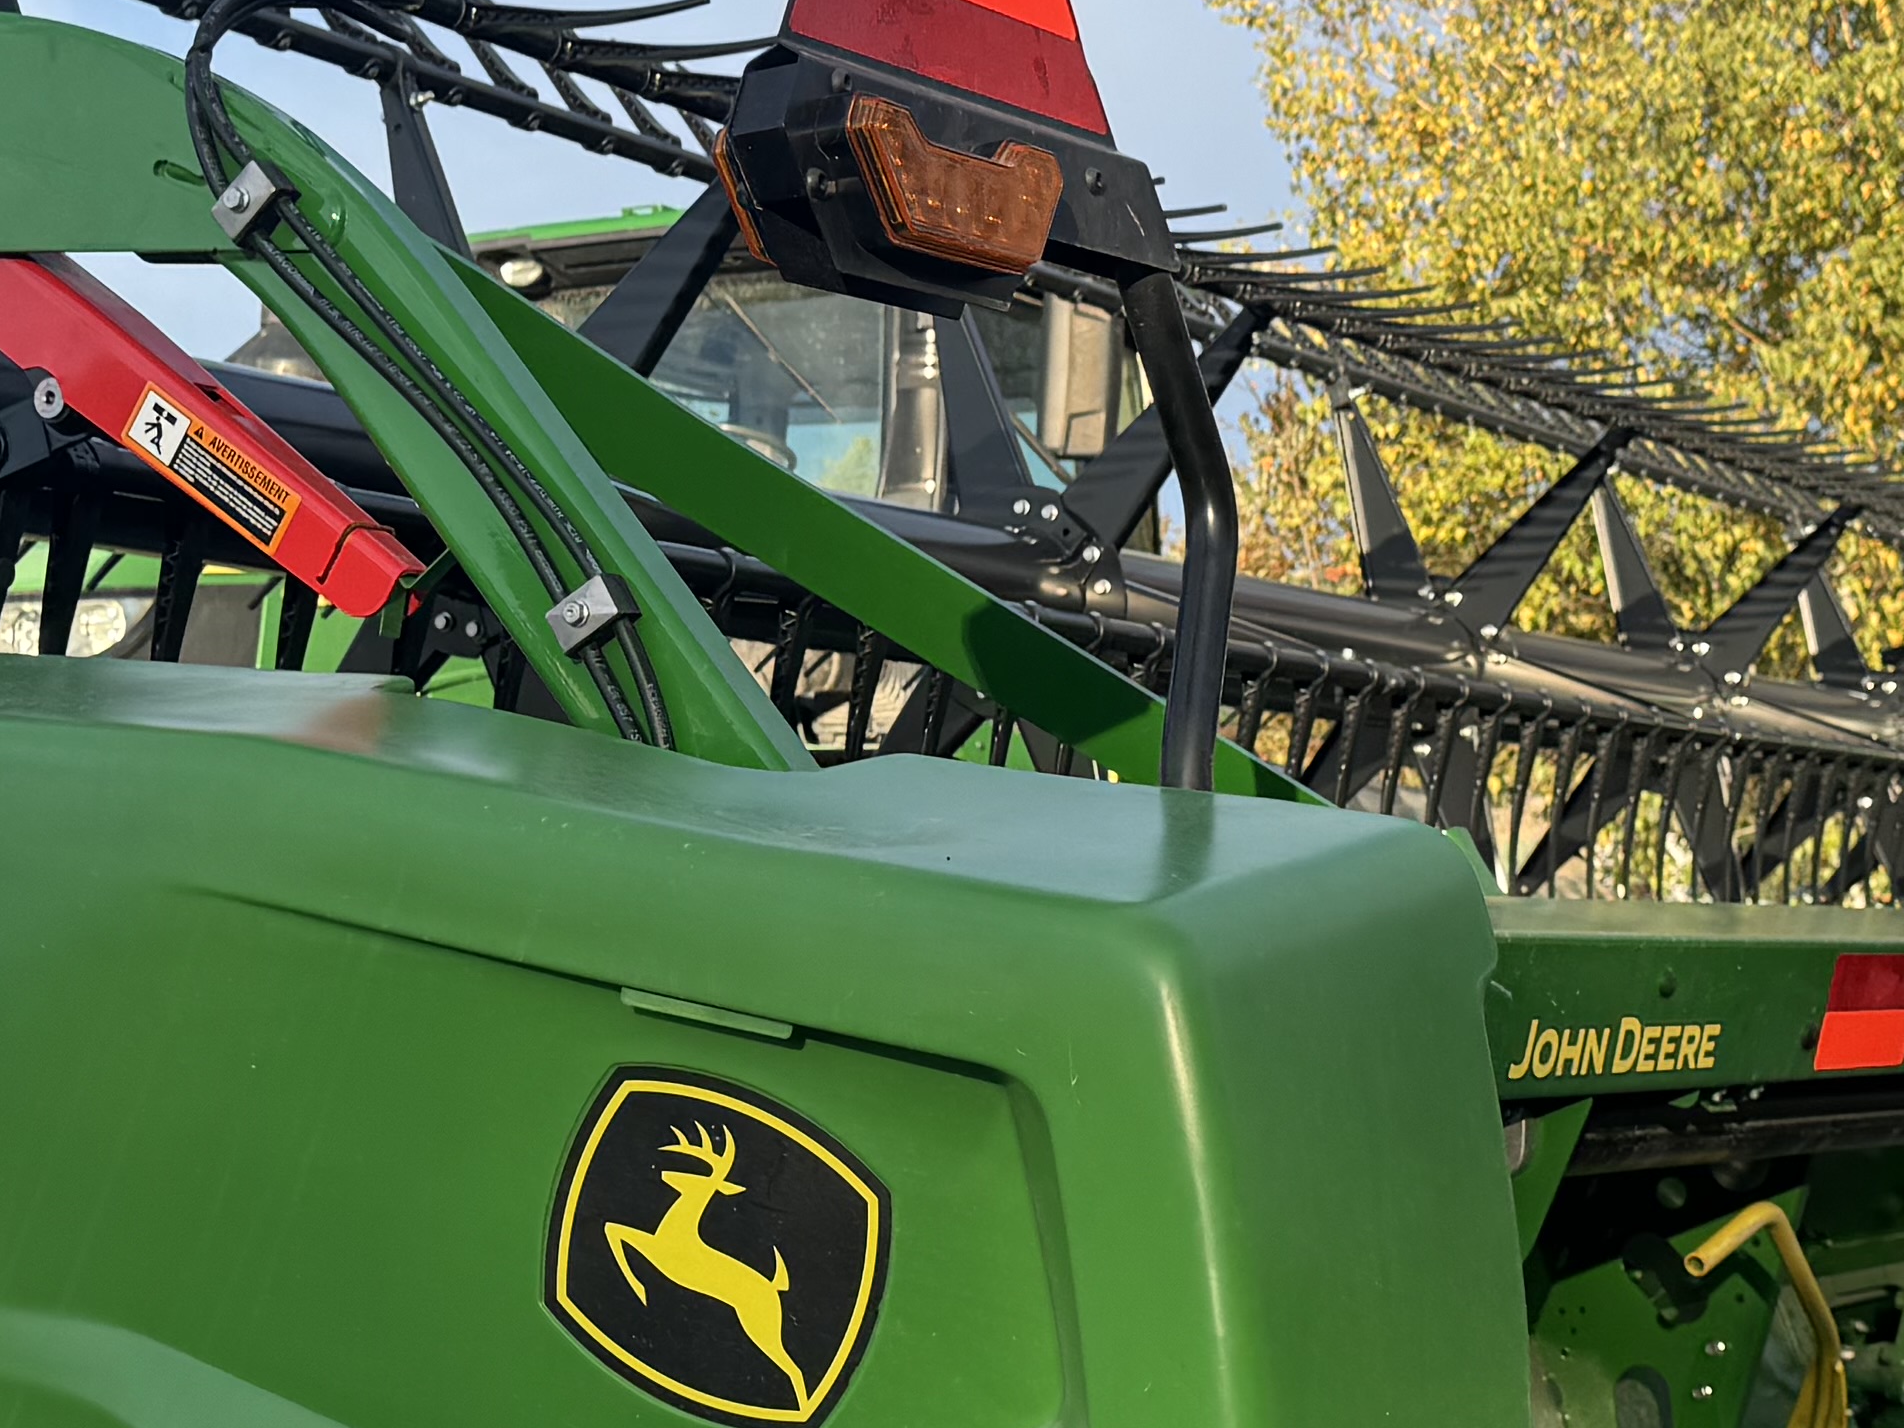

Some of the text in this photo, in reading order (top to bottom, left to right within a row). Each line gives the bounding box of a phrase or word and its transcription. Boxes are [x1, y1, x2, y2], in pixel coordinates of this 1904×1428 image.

[208, 436, 291, 504] AVERTISSEMENT
[1508, 1017, 1721, 1079] JOHN DEERE
